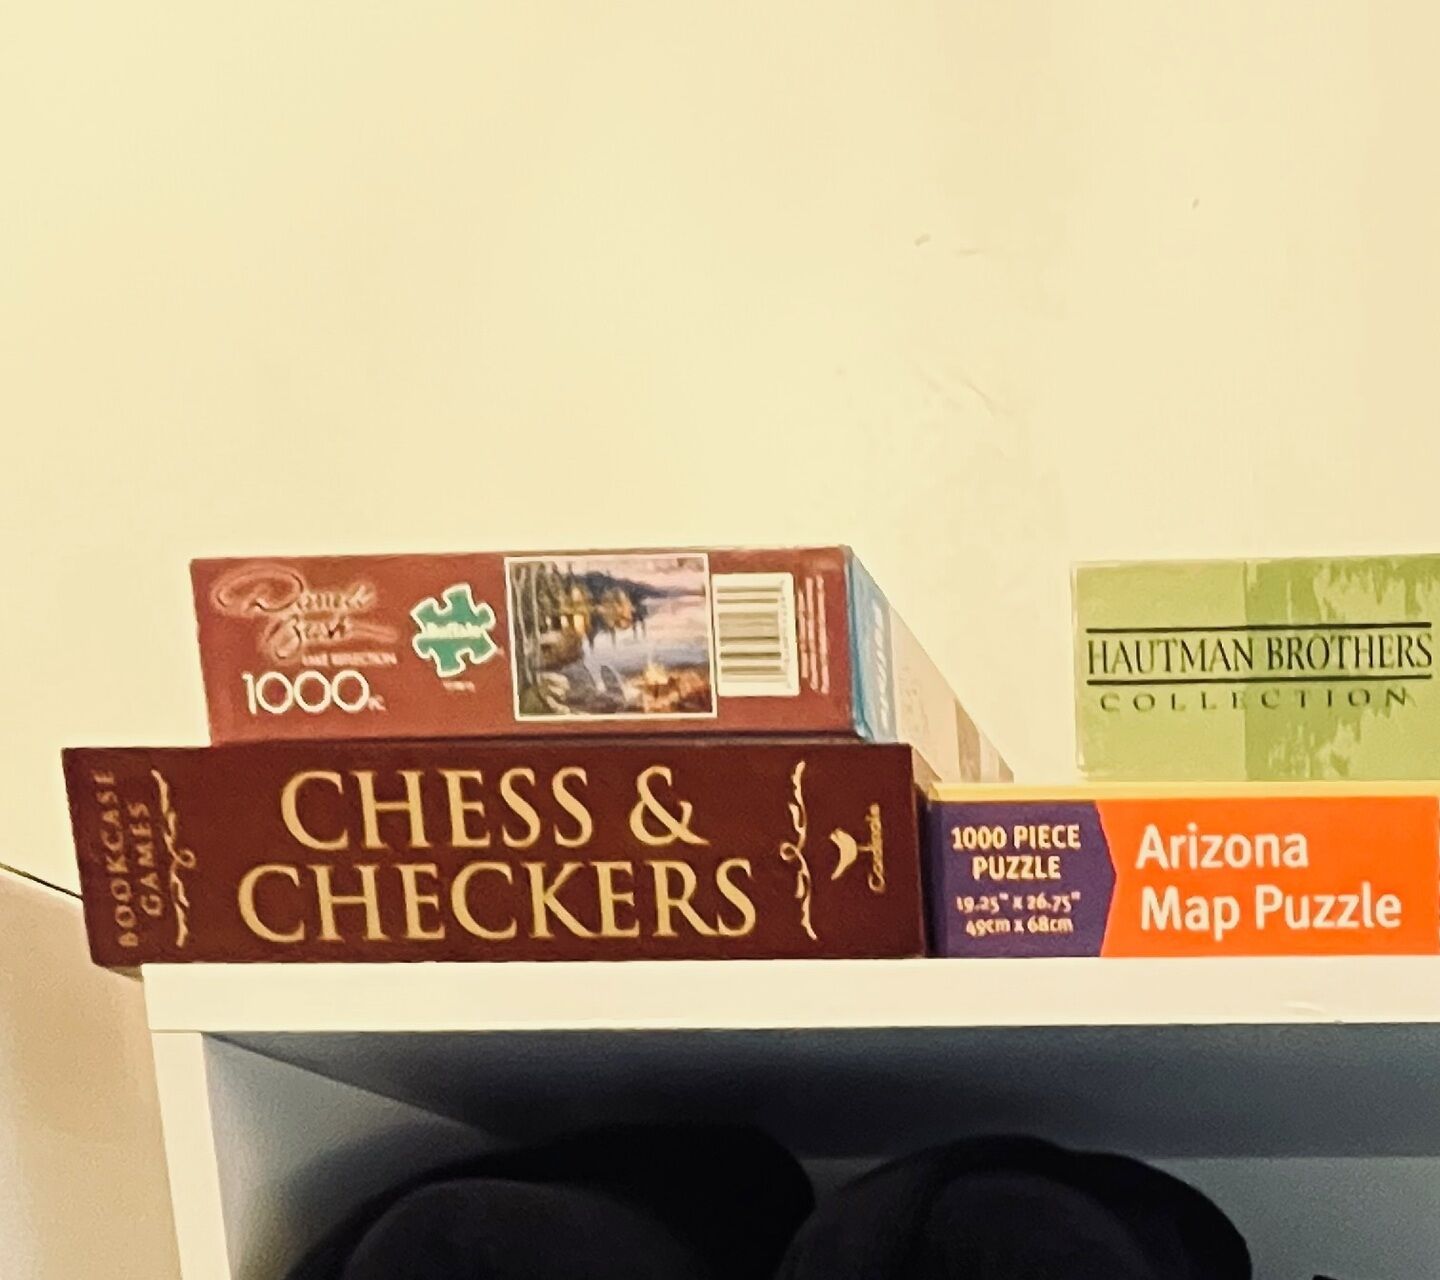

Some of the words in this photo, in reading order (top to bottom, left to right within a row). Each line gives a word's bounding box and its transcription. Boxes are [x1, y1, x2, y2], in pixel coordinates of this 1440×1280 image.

[1087, 635, 1255, 676] HAUTMAN
[1266, 632, 1433, 671] BROTHERS
[1099, 686, 1418, 713] COLLECTION
[280, 766, 594, 851] CHESS
[628, 765, 712, 846] &
[93, 770, 139, 948] BOOKCASE
[126, 801, 164, 918] GAMES
[951, 825, 1008, 850] 1000
[1013, 824, 1082, 849] PIECE
[1135, 822, 1310, 870] Arizona
[972, 856, 1062, 880] PUZZLE
[237, 858, 757, 944] CHECKERS
[1027, 915, 1074, 933] 68cm
[1140, 886, 1241, 943] Map
[1255, 881, 1403, 930] Puzzle
